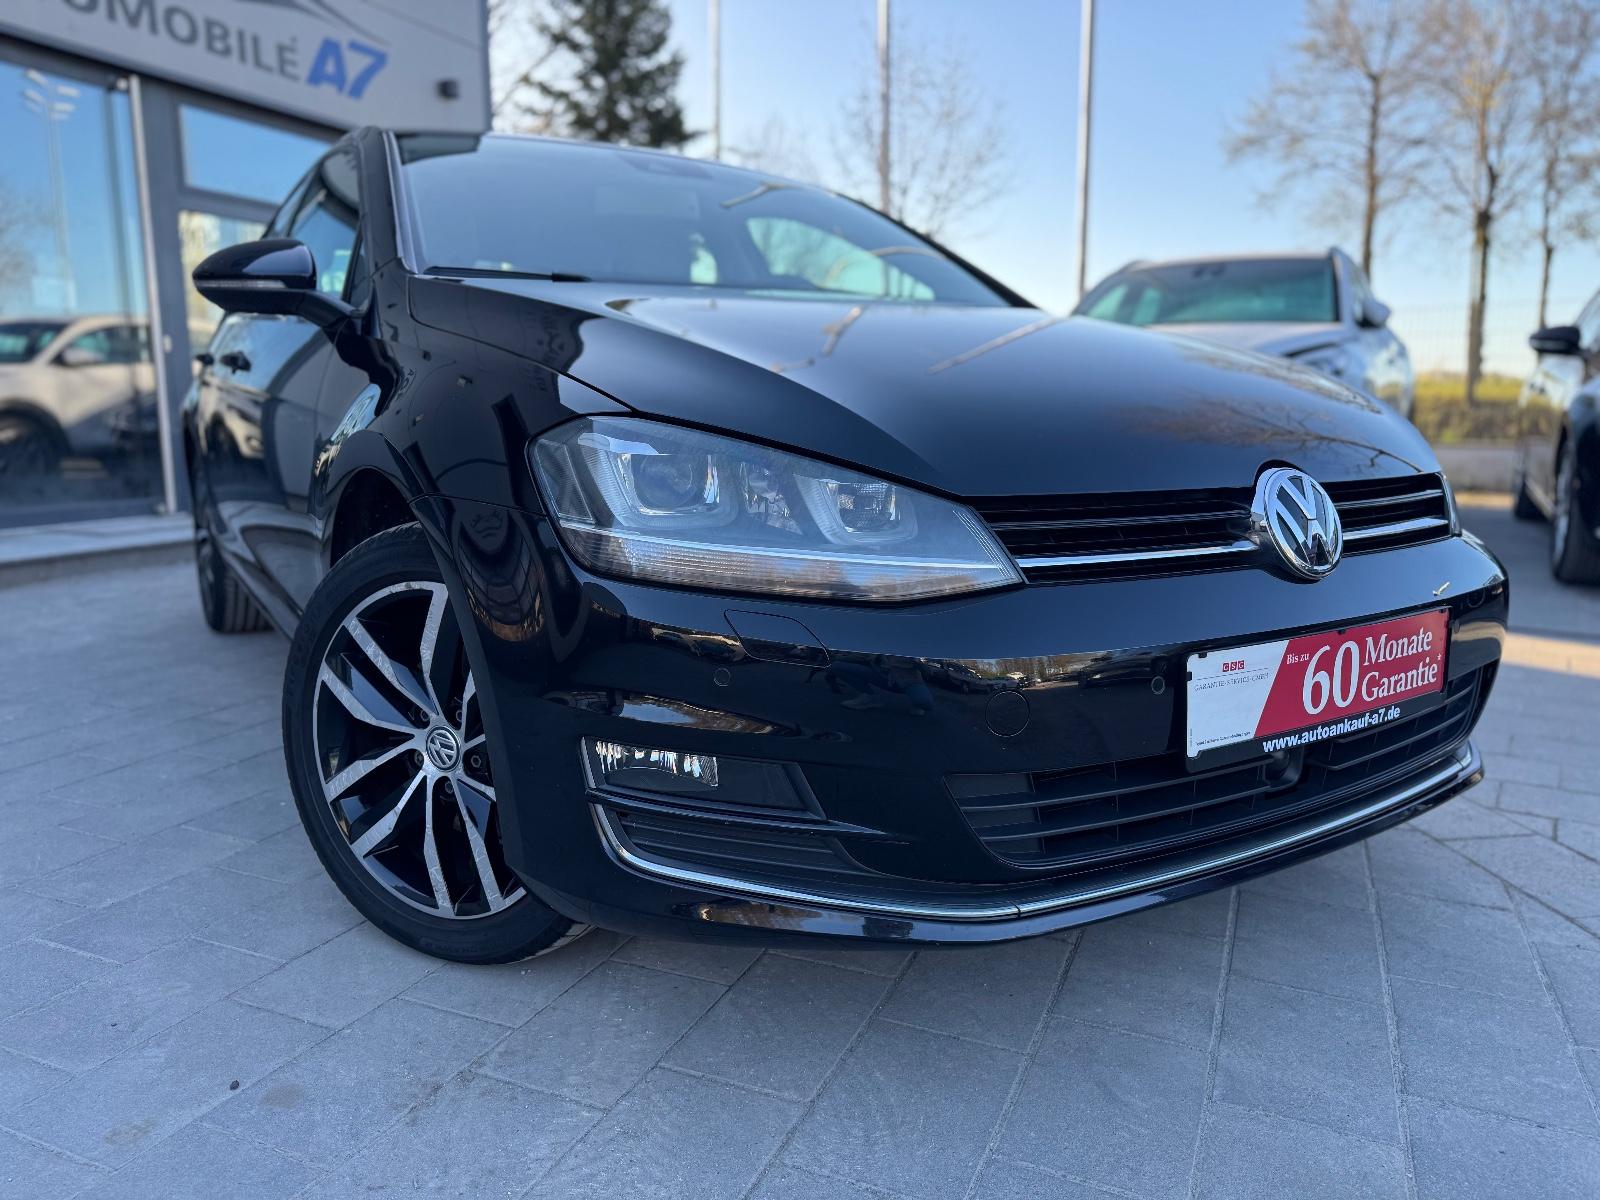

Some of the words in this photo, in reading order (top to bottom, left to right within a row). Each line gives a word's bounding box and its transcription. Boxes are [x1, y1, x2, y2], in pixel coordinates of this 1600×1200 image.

[306, 37, 389, 100] A7
[1286, 653, 1299, 665] Bis
[1300, 653, 1310, 663] zu
[1363, 626, 1433, 667] Monate
[1303, 640, 1360, 715] 60
[1263, 706, 1401, 753] www.autoankauf-a7.de
